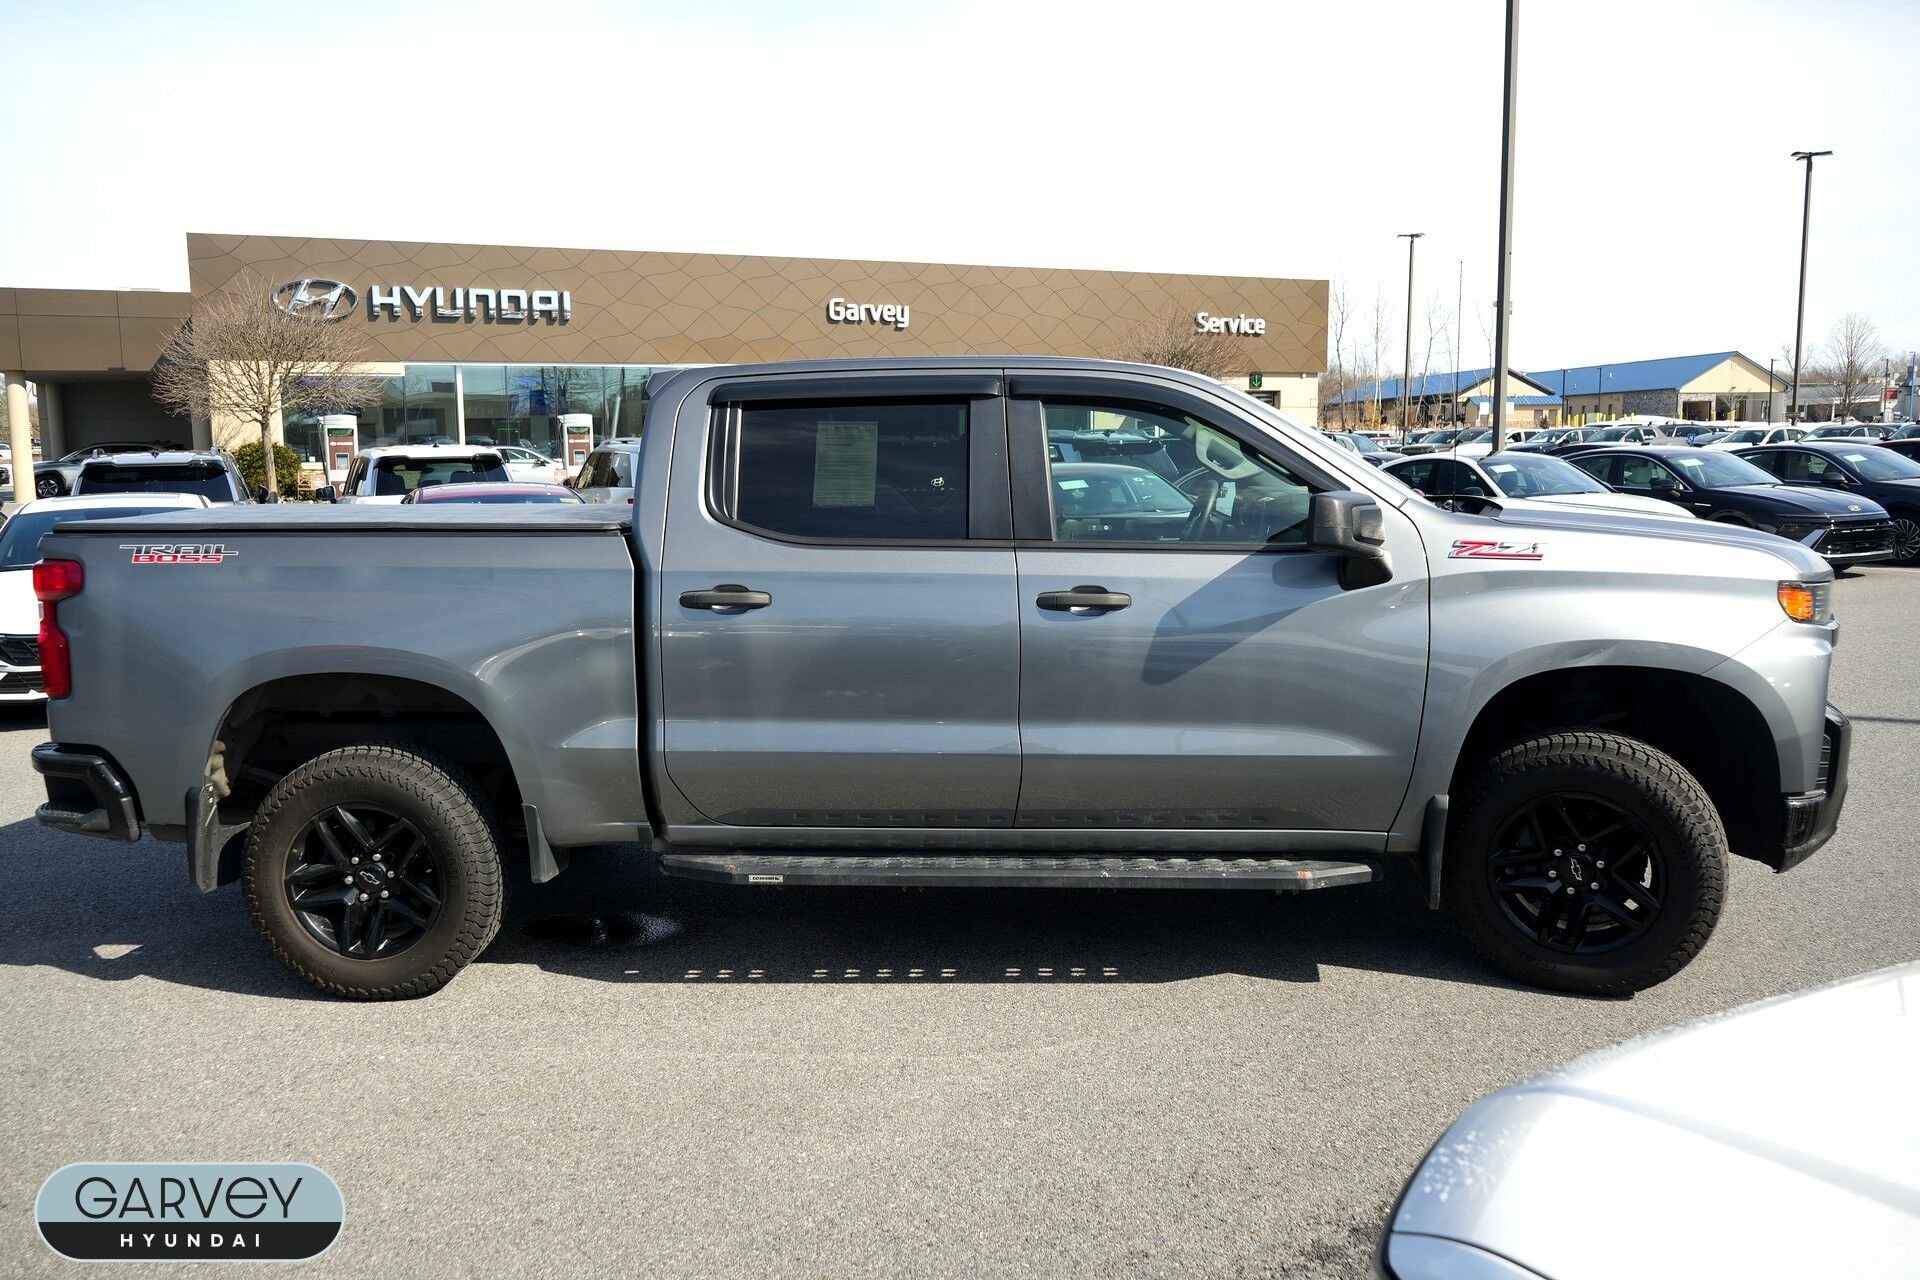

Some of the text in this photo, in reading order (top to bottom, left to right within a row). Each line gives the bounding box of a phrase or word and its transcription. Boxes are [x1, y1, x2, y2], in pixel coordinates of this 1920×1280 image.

[370, 284, 572, 322] HYUNDAI
[828, 297, 910, 328] Garvey
[1196, 312, 1266, 335] Service
[119, 543, 239, 556] TRAIL
[132, 553, 223, 564] BOSS
[1447, 539, 1547, 561] Z71
